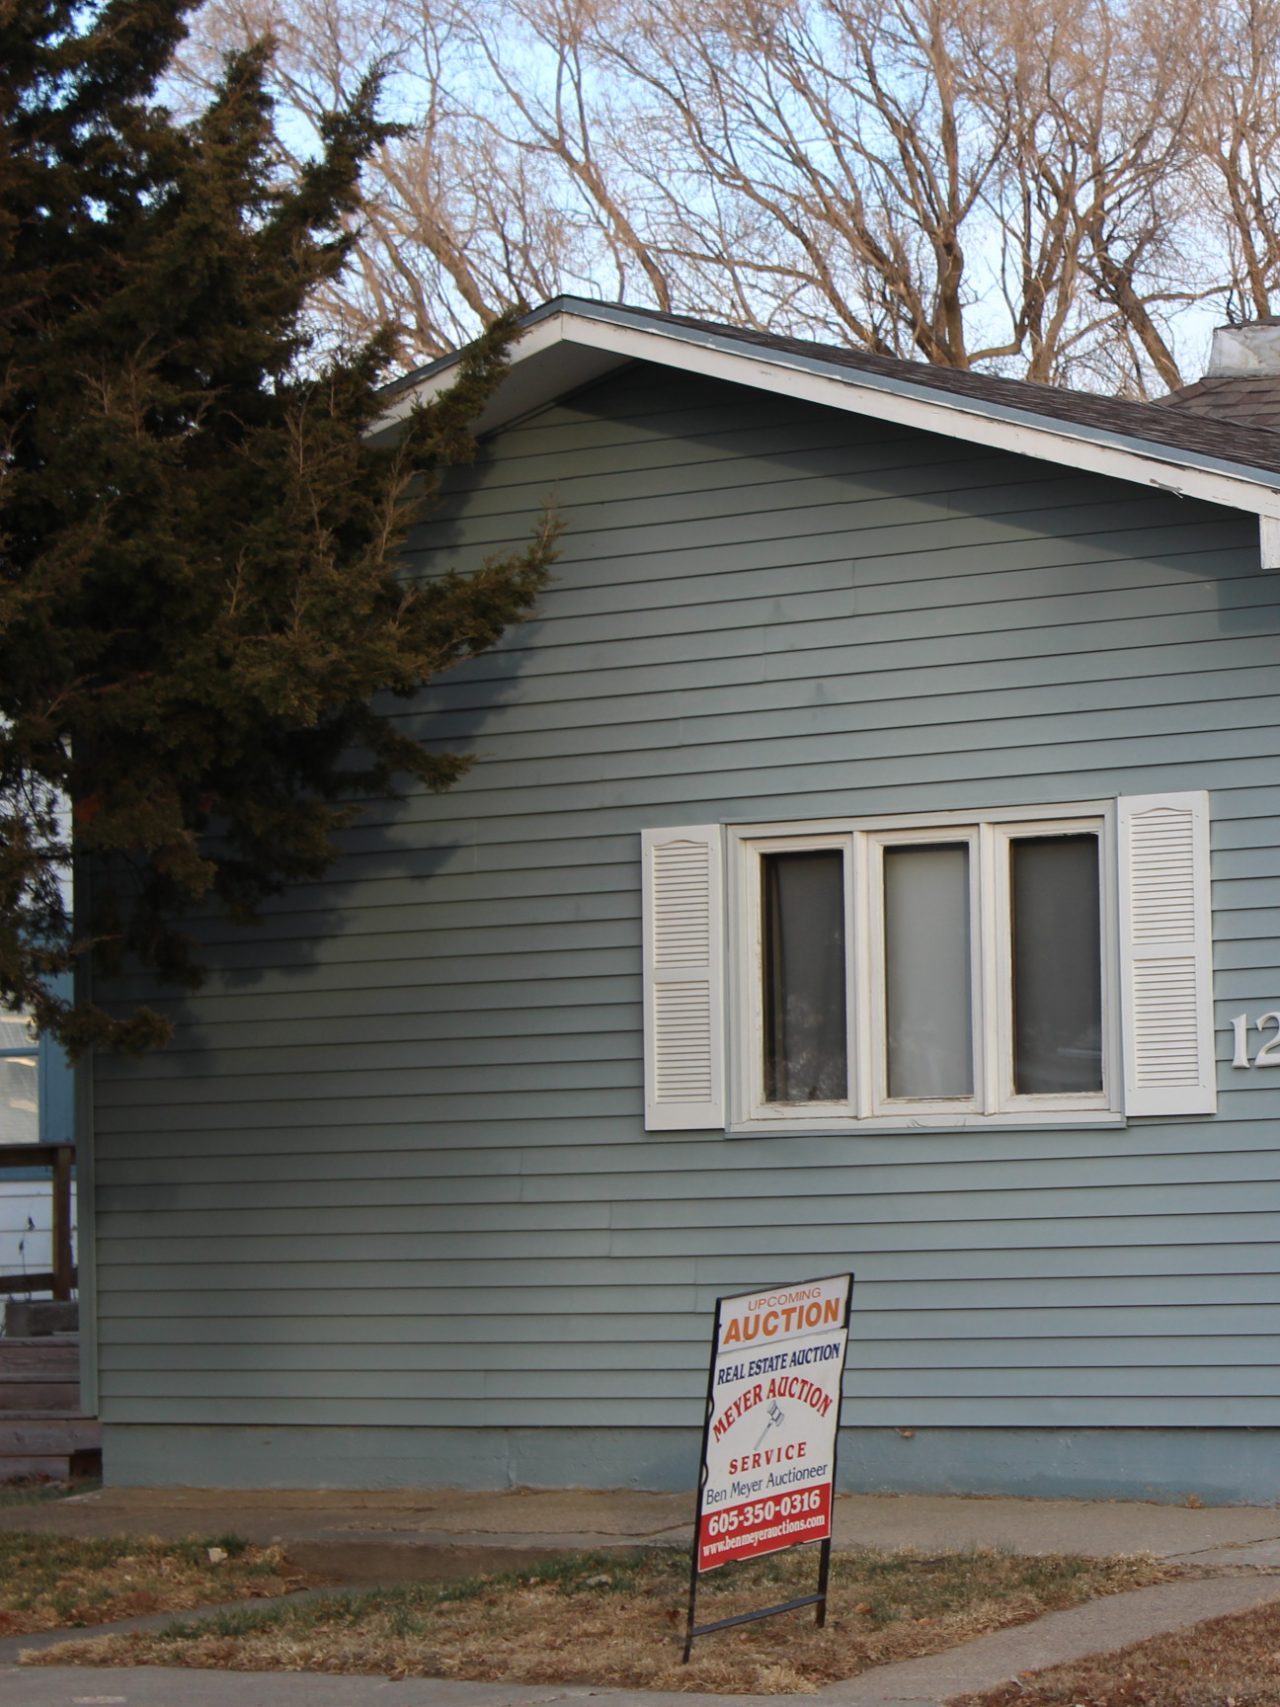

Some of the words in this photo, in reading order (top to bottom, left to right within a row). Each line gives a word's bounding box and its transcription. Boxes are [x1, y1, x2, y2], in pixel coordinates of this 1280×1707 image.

[723, 1297, 840, 1345] AUCTION
[748, 1287, 821, 1312] UPCOMING
[717, 1363, 746, 1386] REAL
[747, 1352, 788, 1378] ESTATE
[789, 1342, 840, 1368] AUCTION
[712, 1383, 763, 1443] MEYER
[767, 1376, 832, 1418] AUCTION
[728, 1441, 807, 1475] SERVICE
[706, 1488, 727, 1506] Ben
[730, 1478, 763, 1501] Meyer
[767, 1463, 828, 1488] Auctioneer
[708, 1490, 821, 1537] 605-350-0316
[702, 1515, 826, 1557] www.benmeyerauctions.com
